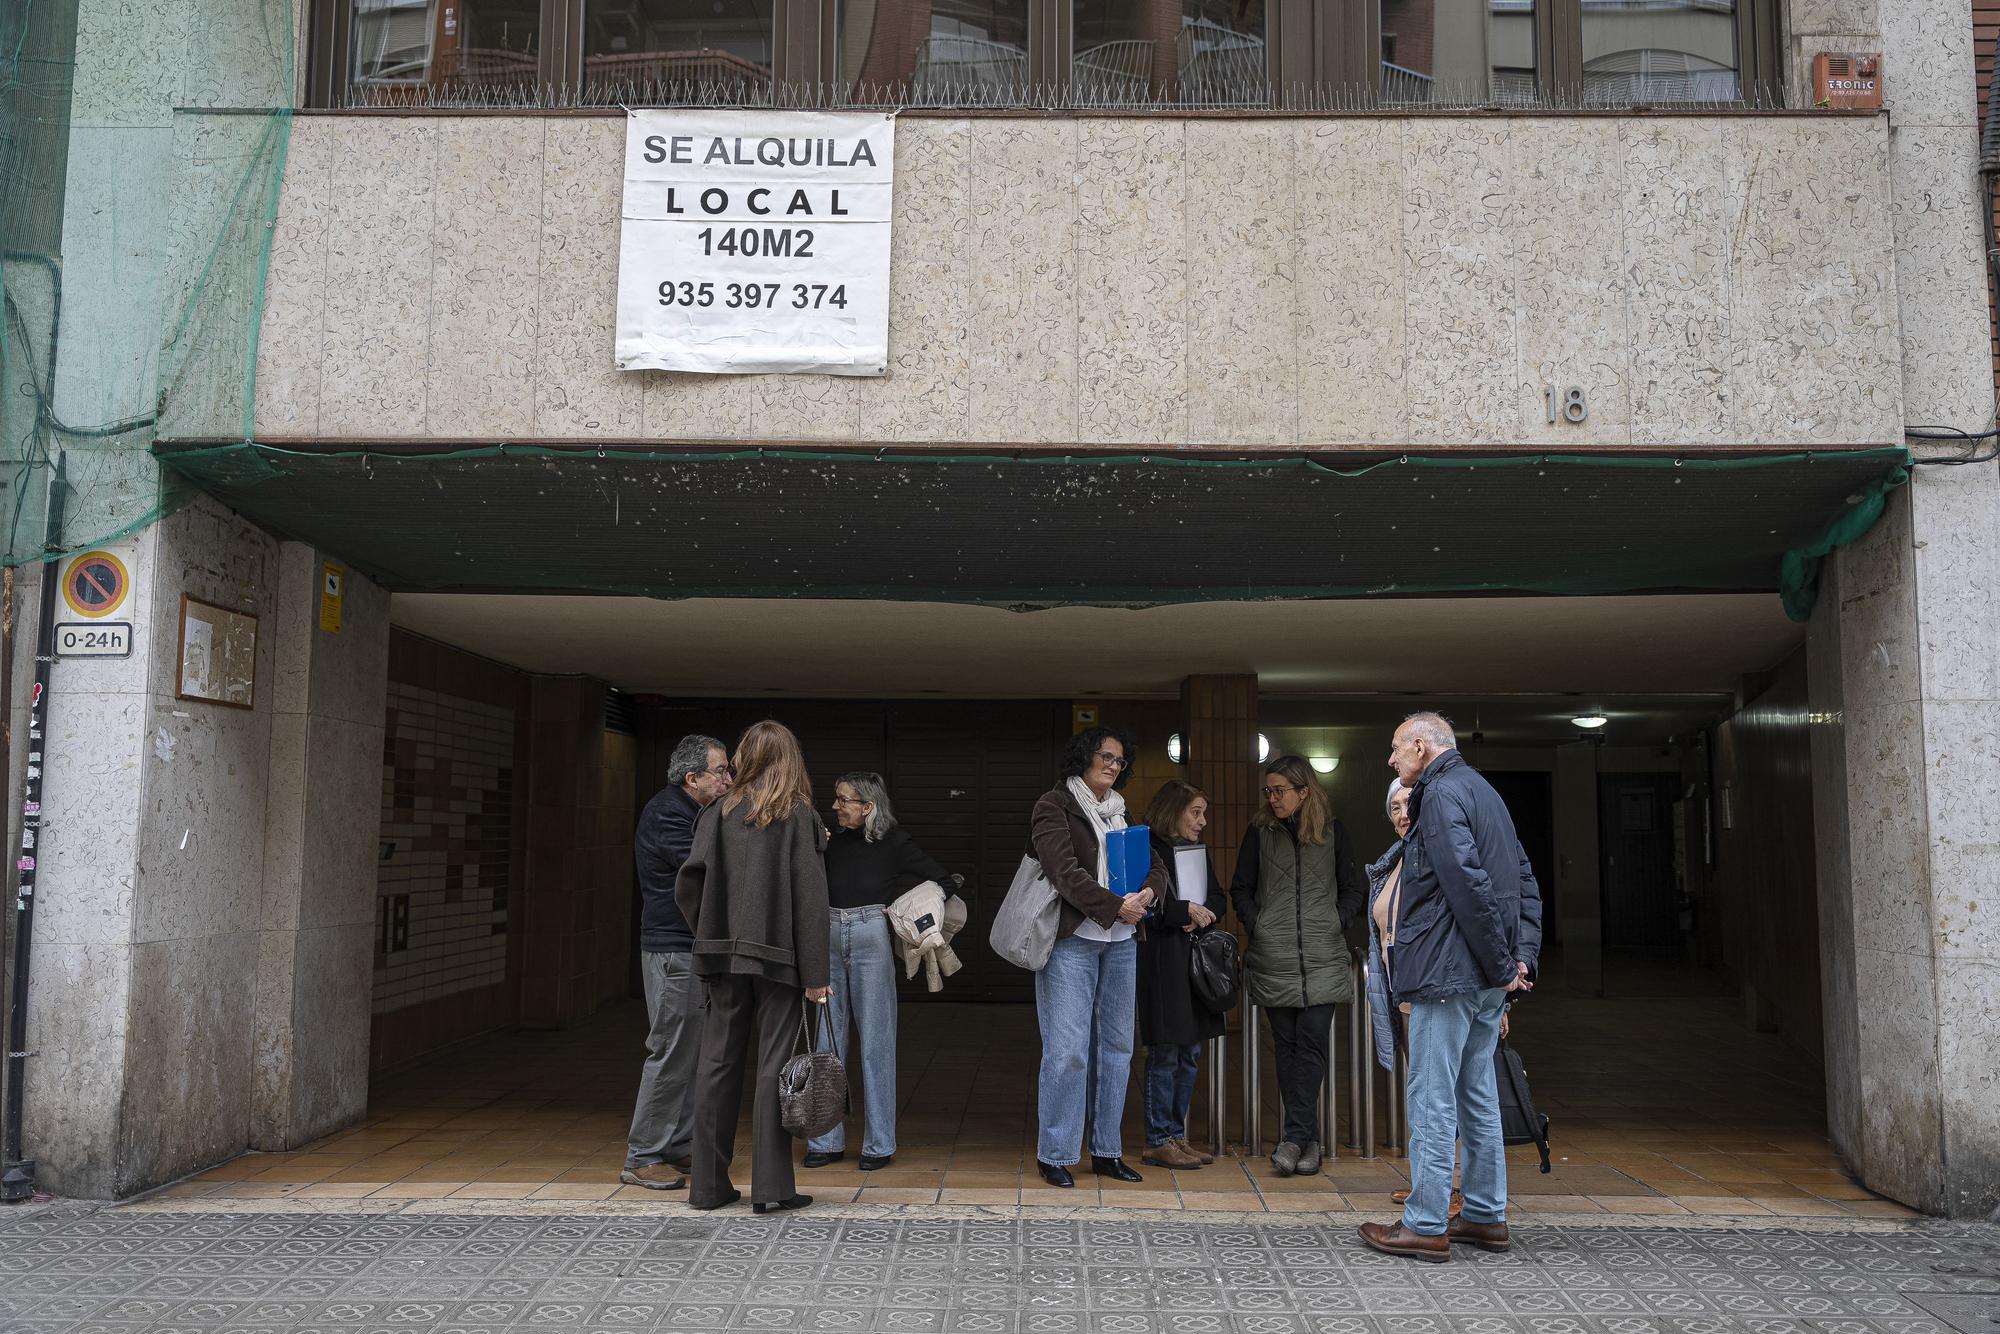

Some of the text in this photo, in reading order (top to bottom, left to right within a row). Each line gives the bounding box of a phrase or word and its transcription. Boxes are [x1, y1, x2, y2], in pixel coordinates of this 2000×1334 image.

[643, 135, 877, 168] SE ALQUILA
[666, 187, 849, 216] LOCAL
[698, 227, 815, 258] 140M2
[658, 281, 848, 310] 935 397 374
[1544, 385, 1588, 424] 18
[63, 632, 122, 648] 0-24h
